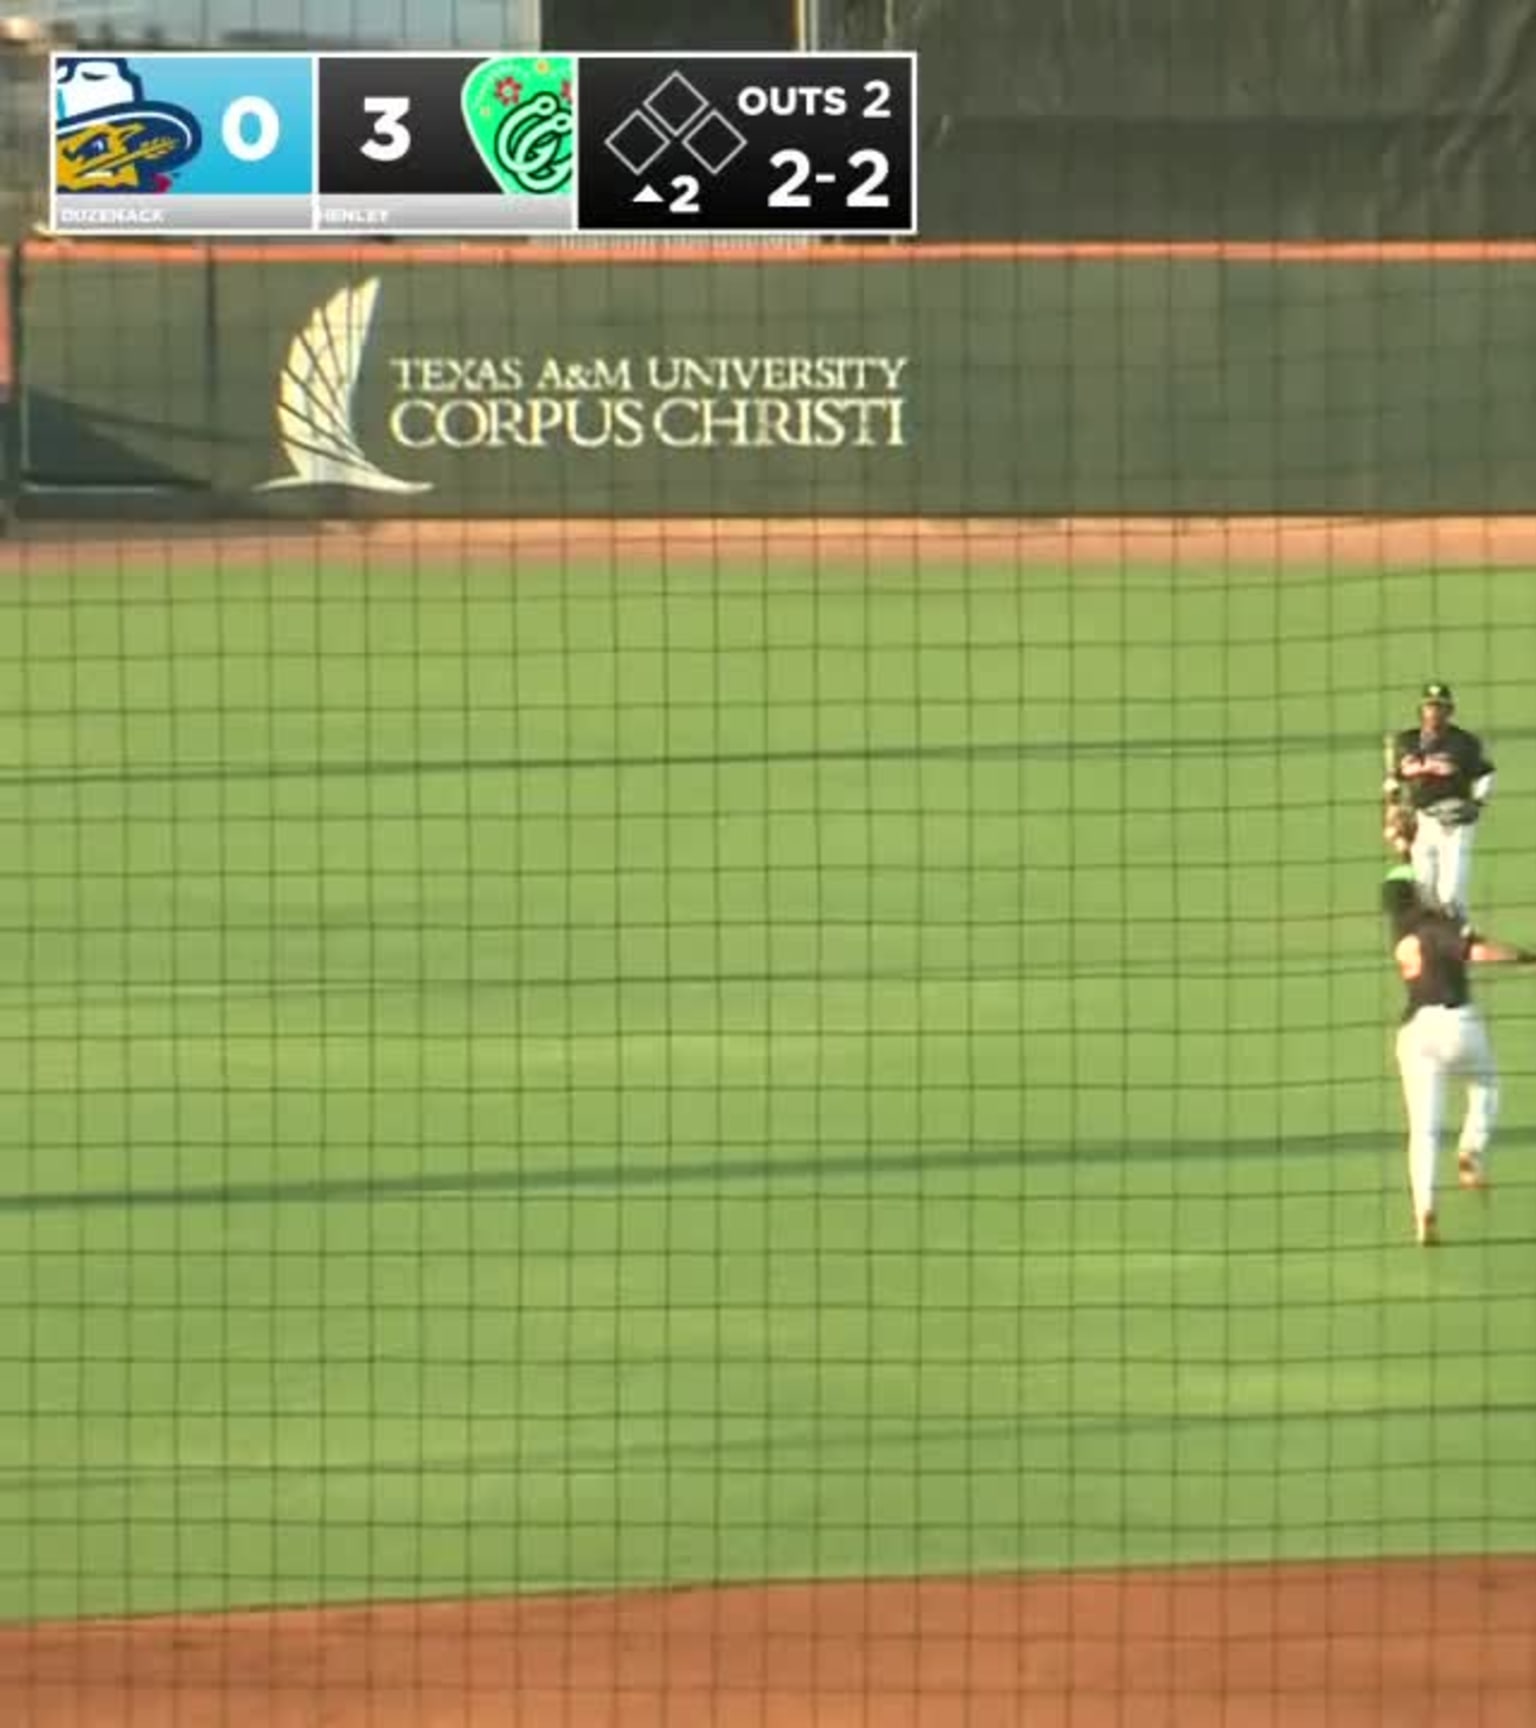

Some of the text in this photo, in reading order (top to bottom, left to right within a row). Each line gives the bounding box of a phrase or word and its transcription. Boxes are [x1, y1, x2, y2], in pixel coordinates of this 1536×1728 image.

[391, 356, 908, 391] TEXAS A&M UNIVERSITY
[390, 399, 906, 448] CORPUS CHRISTI
